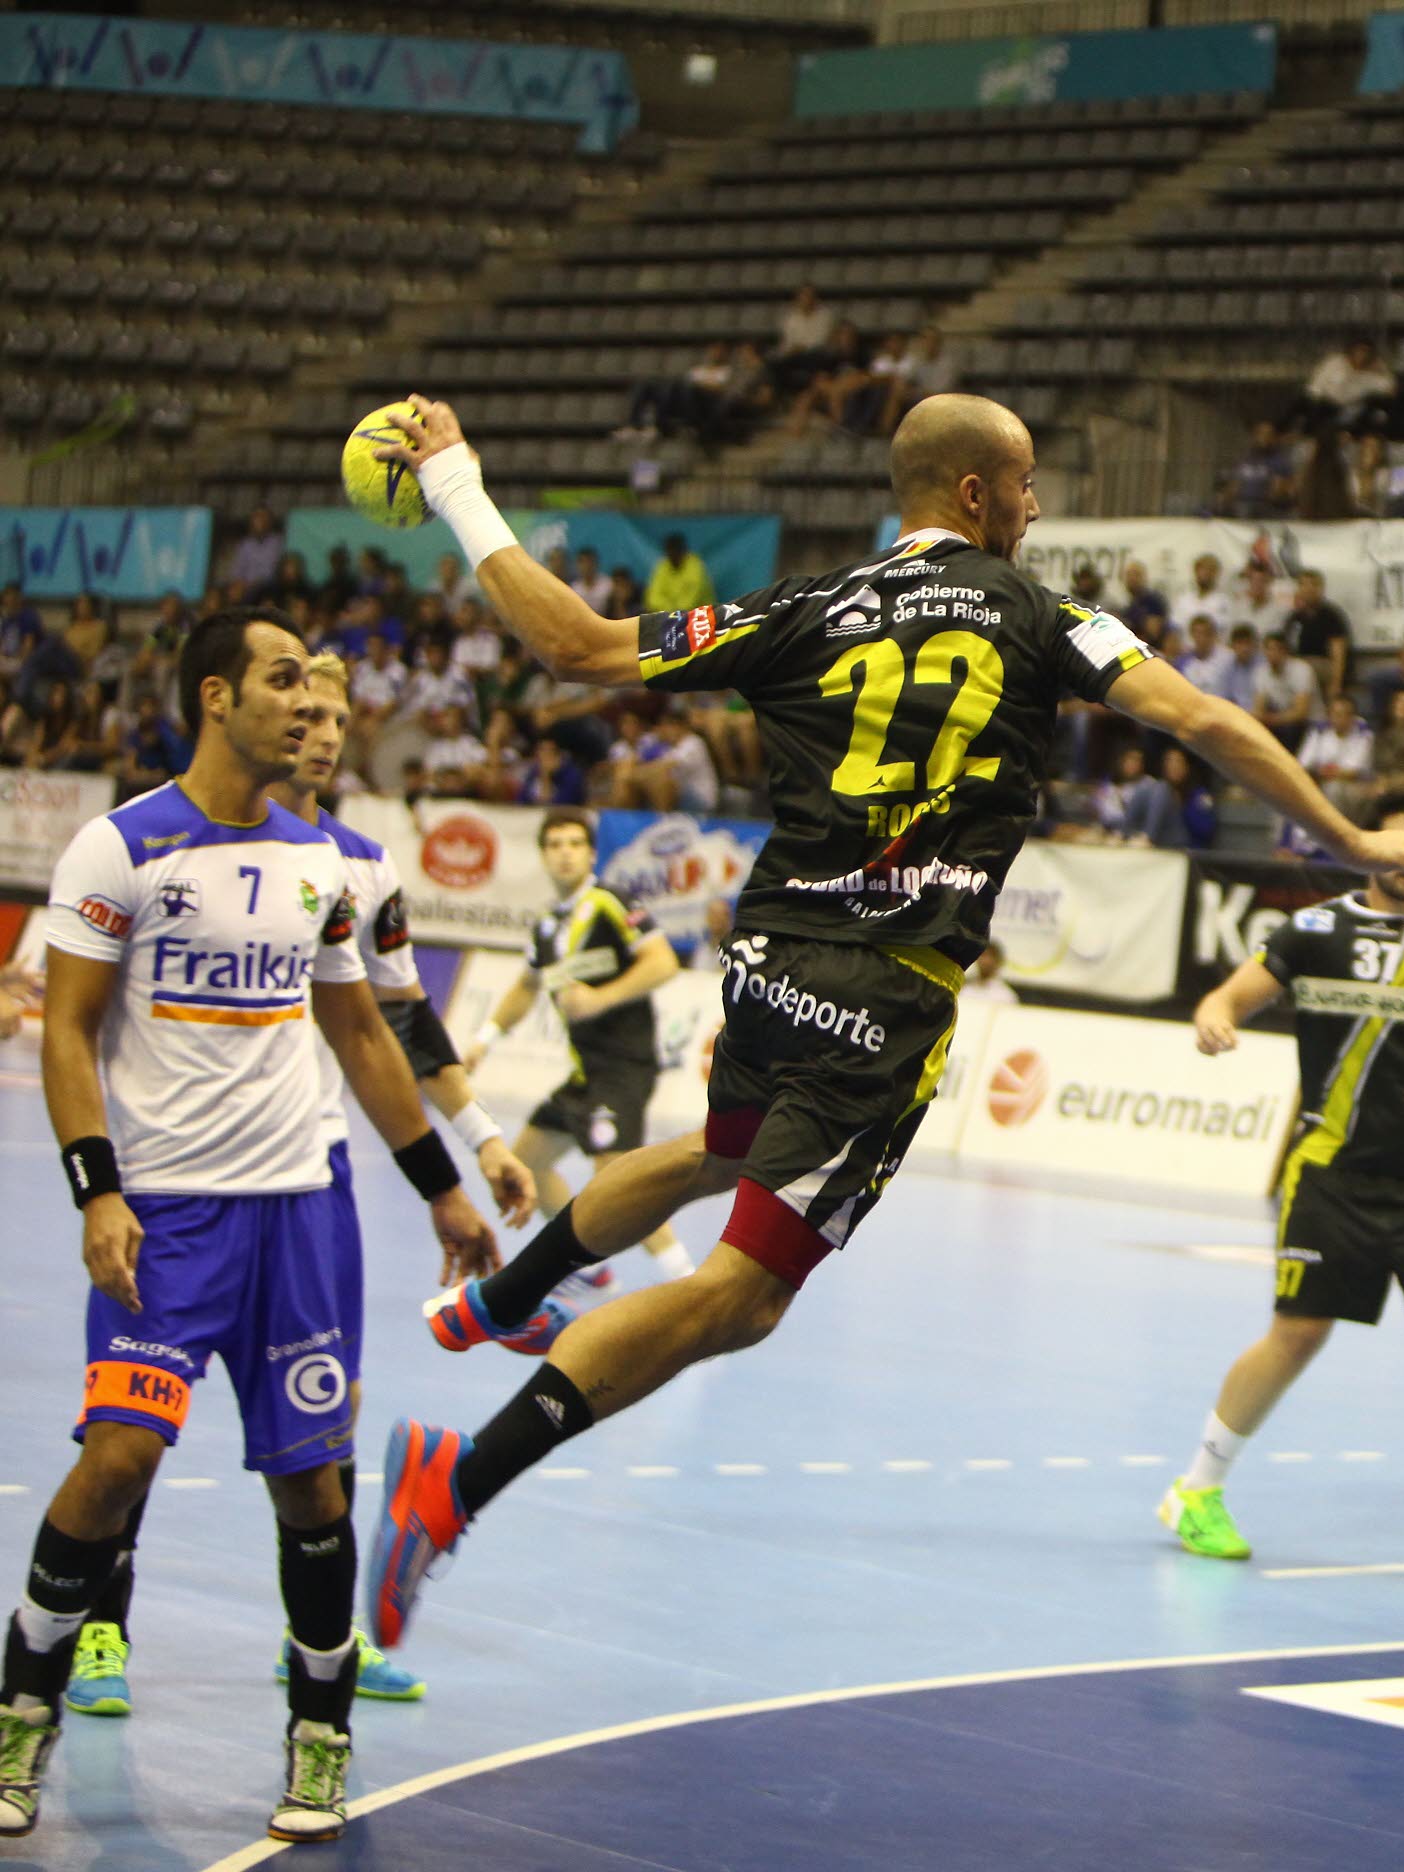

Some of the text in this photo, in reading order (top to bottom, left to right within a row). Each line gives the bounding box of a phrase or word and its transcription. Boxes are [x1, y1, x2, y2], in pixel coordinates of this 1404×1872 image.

[883, 564, 947, 579] MERCURY
[892, 601, 1002, 627] de La Rioja
[896, 584, 986, 607] Gobierno
[818, 629, 1005, 796] 22
[238, 865, 262, 915] 7
[868, 878, 888, 891] de
[1352, 937, 1402, 985] 37
[1057, 1079, 1280, 1142] euromadi
